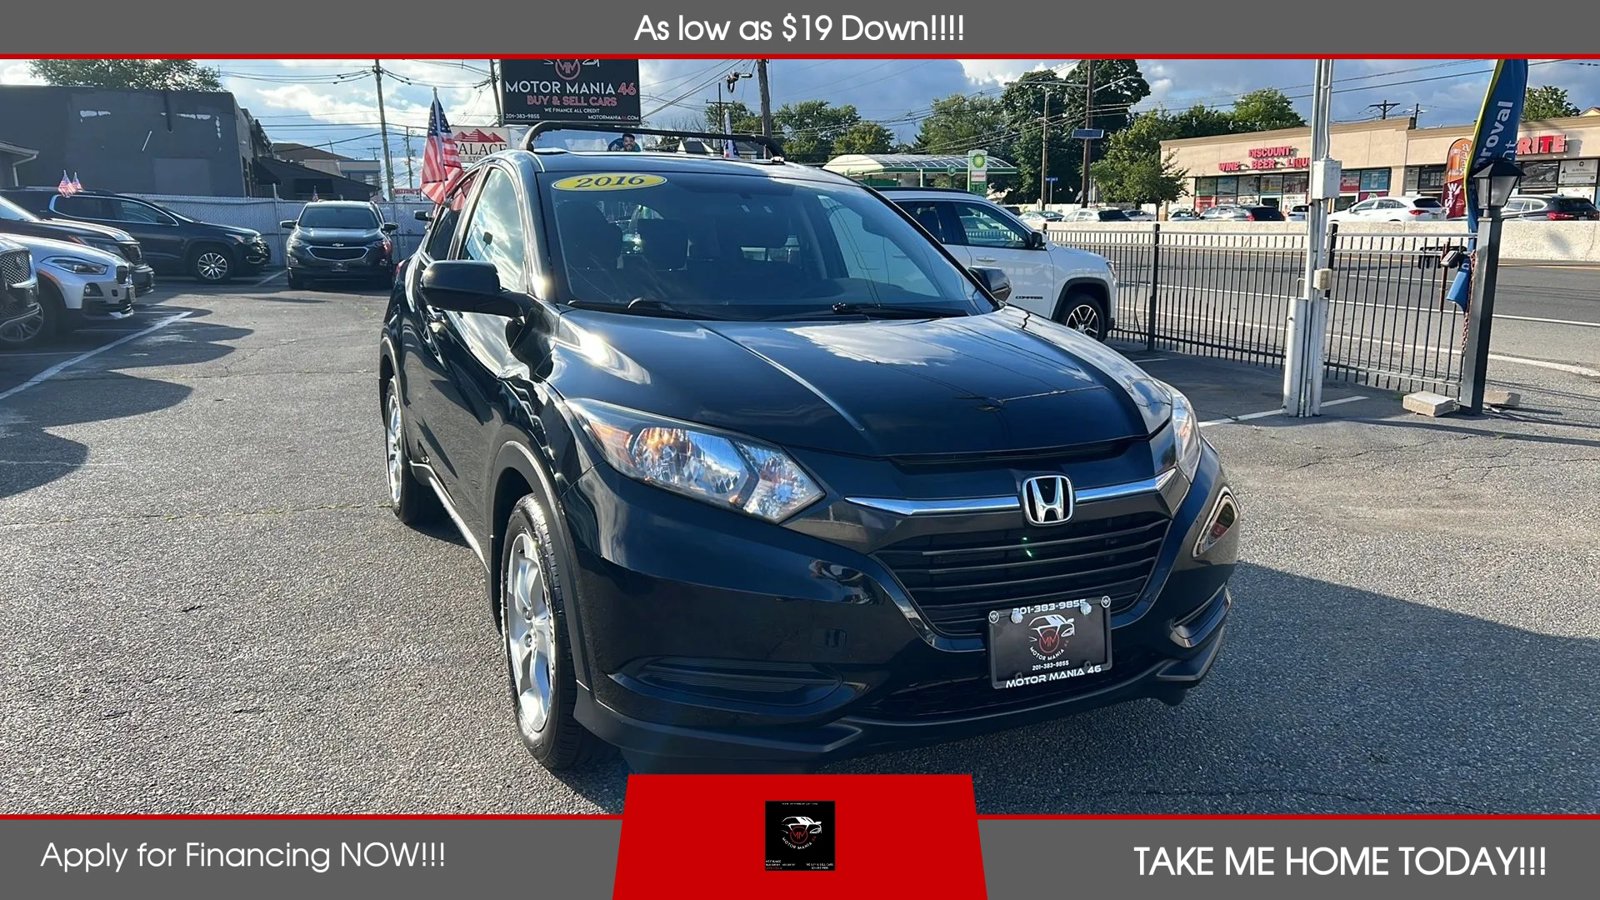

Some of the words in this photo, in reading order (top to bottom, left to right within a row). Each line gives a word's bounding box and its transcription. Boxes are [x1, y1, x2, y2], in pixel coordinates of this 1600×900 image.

[505, 81, 560, 93] MOTOR
[566, 82, 615, 95] MANIA
[618, 82, 637, 96] 46
[527, 95, 549, 105] BUY
[552, 95, 560, 106] &
[563, 95, 587, 106] SELL
[589, 97, 617, 107] CARS
[1248, 146, 1292, 159] DISCOUNT
[1219, 161, 1240, 171] WINE
[1252, 159, 1276, 169] BEER
[575, 175, 646, 188] 2016
[1029, 646, 1047, 661] MOTOR
[1005, 674, 1047, 689] MOTOR
[1049, 667, 1086, 682] MANIA
[1087, 664, 1102, 675] 46
